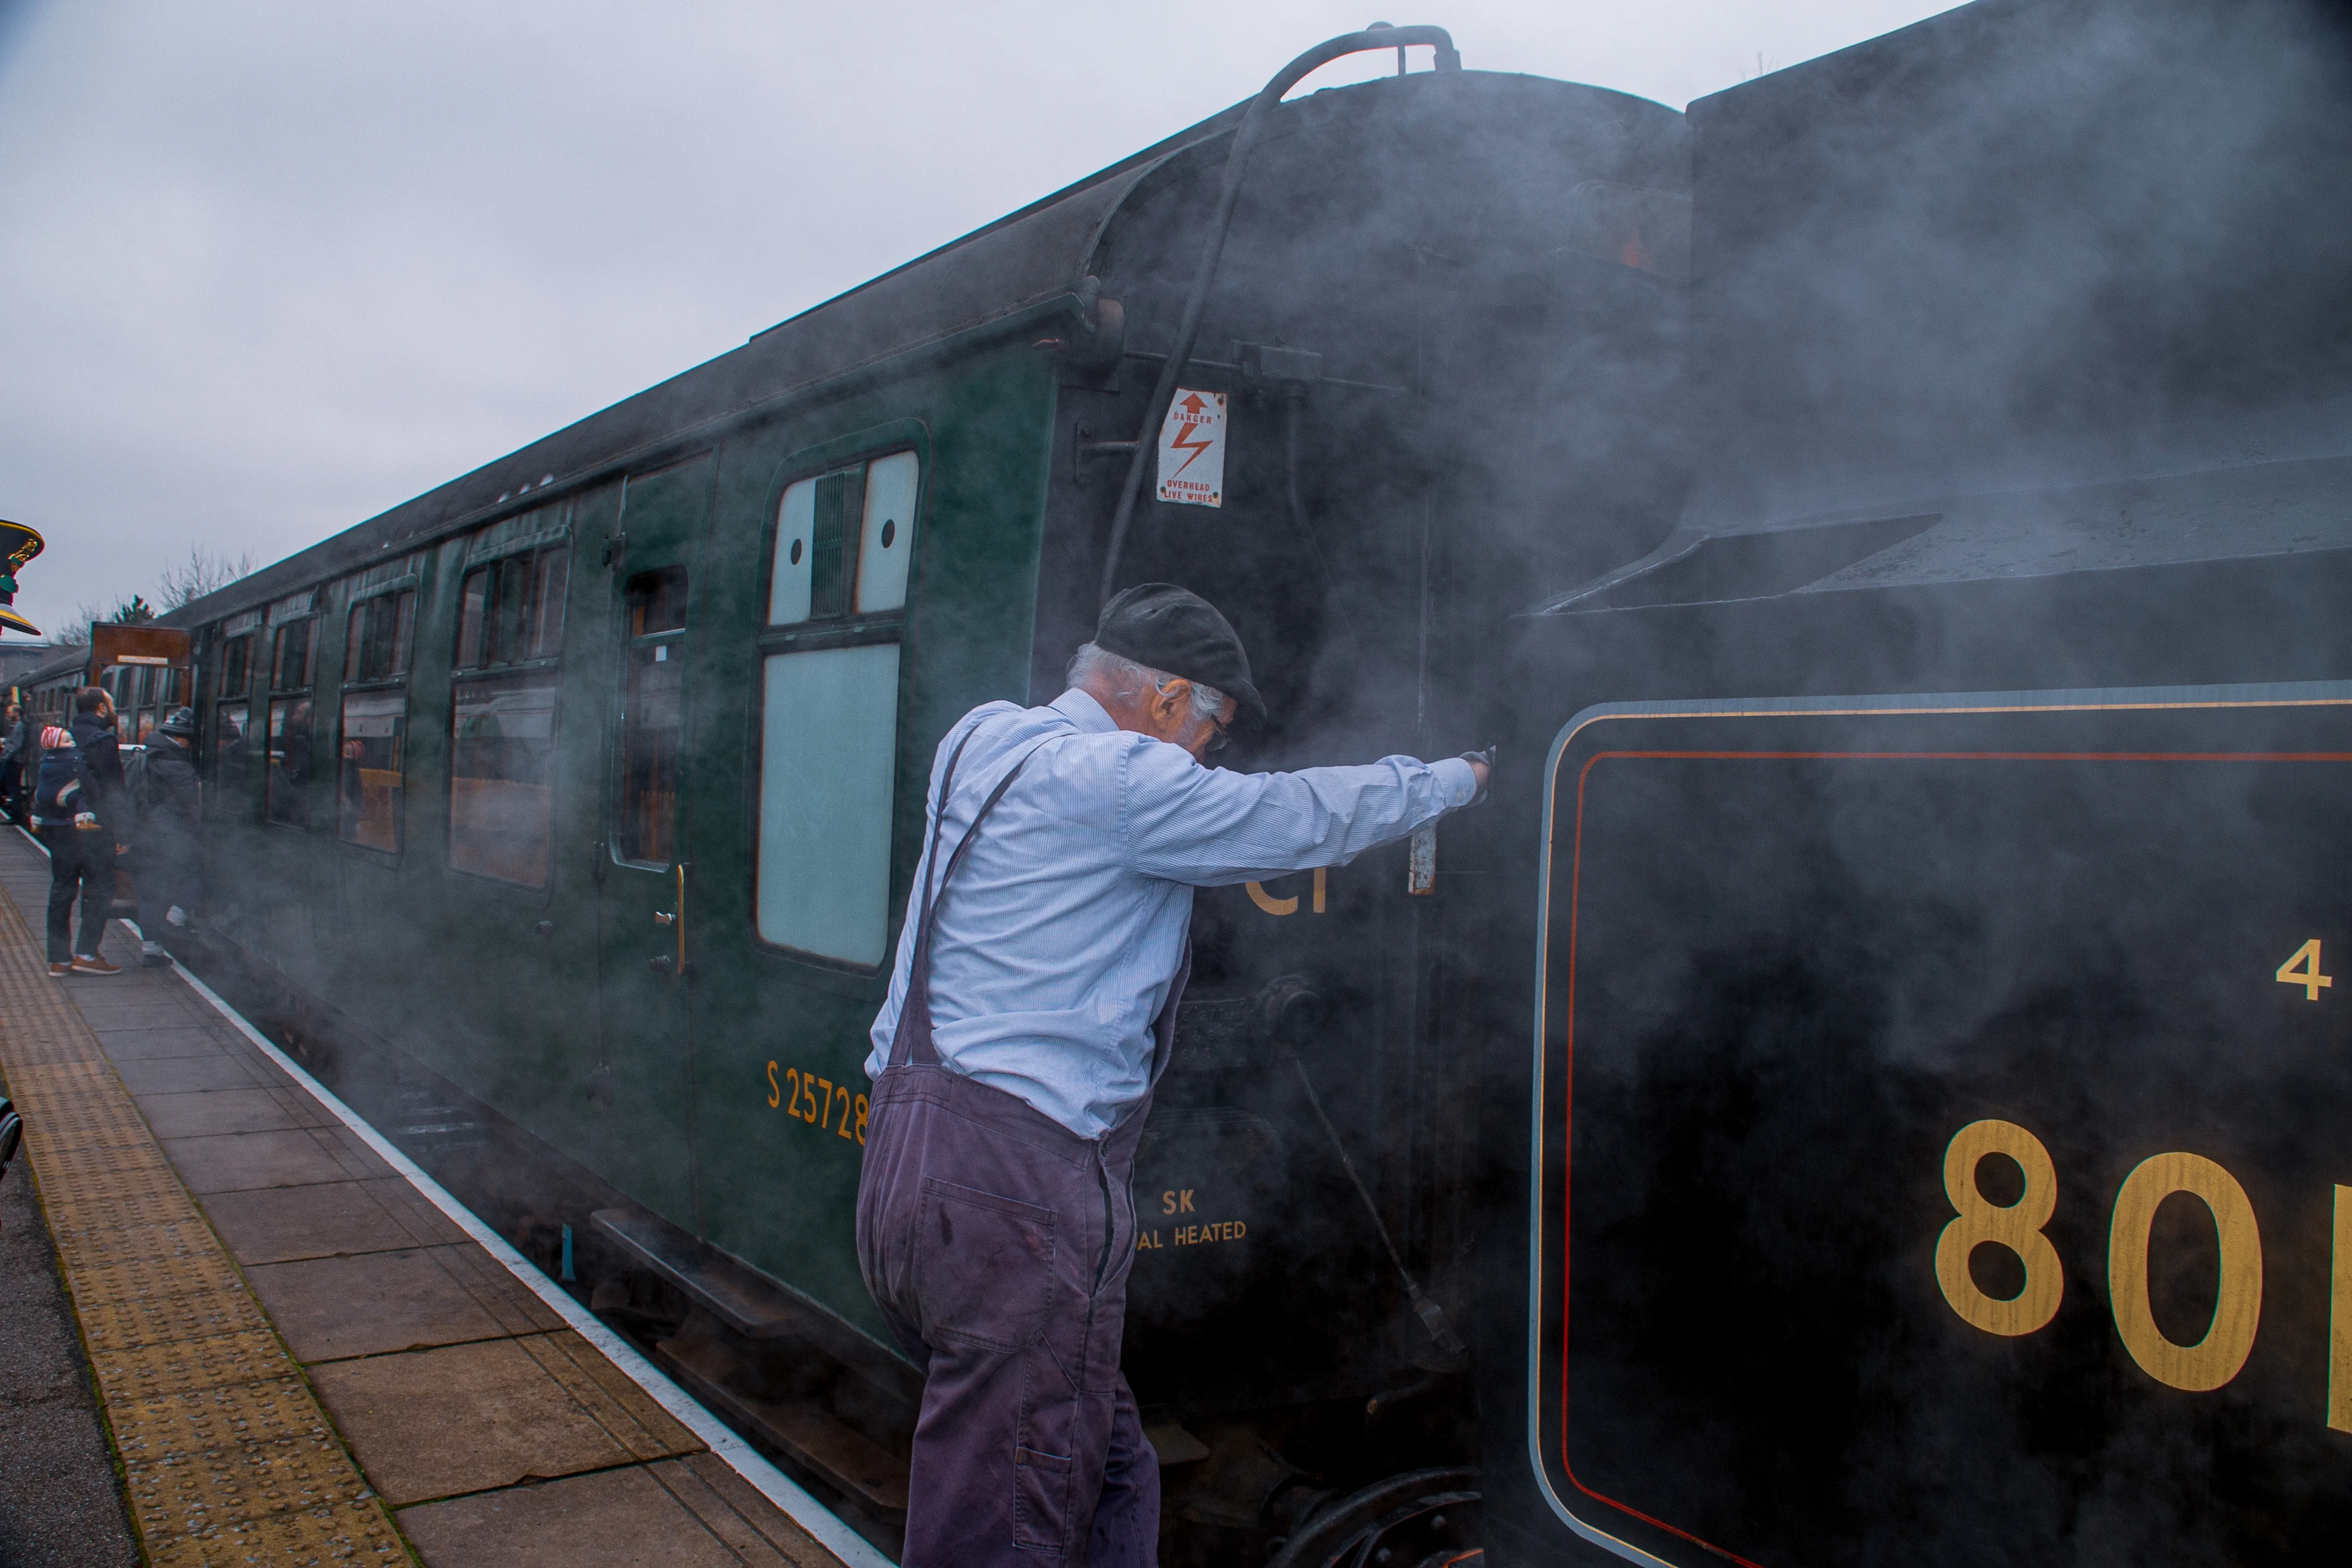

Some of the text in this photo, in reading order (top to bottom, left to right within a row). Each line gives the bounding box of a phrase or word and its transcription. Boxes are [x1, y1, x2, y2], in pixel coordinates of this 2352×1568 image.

[1174, 412, 1212, 425] DANGER
[1166, 479, 1210, 492] OVERHEAD
[1164, 490, 1213, 503] LIVE WIRES
[2276, 939, 2333, 1001] 4
[1163, 1189, 1195, 1215] SK
[1175, 1221, 1247, 1246] HEATED
